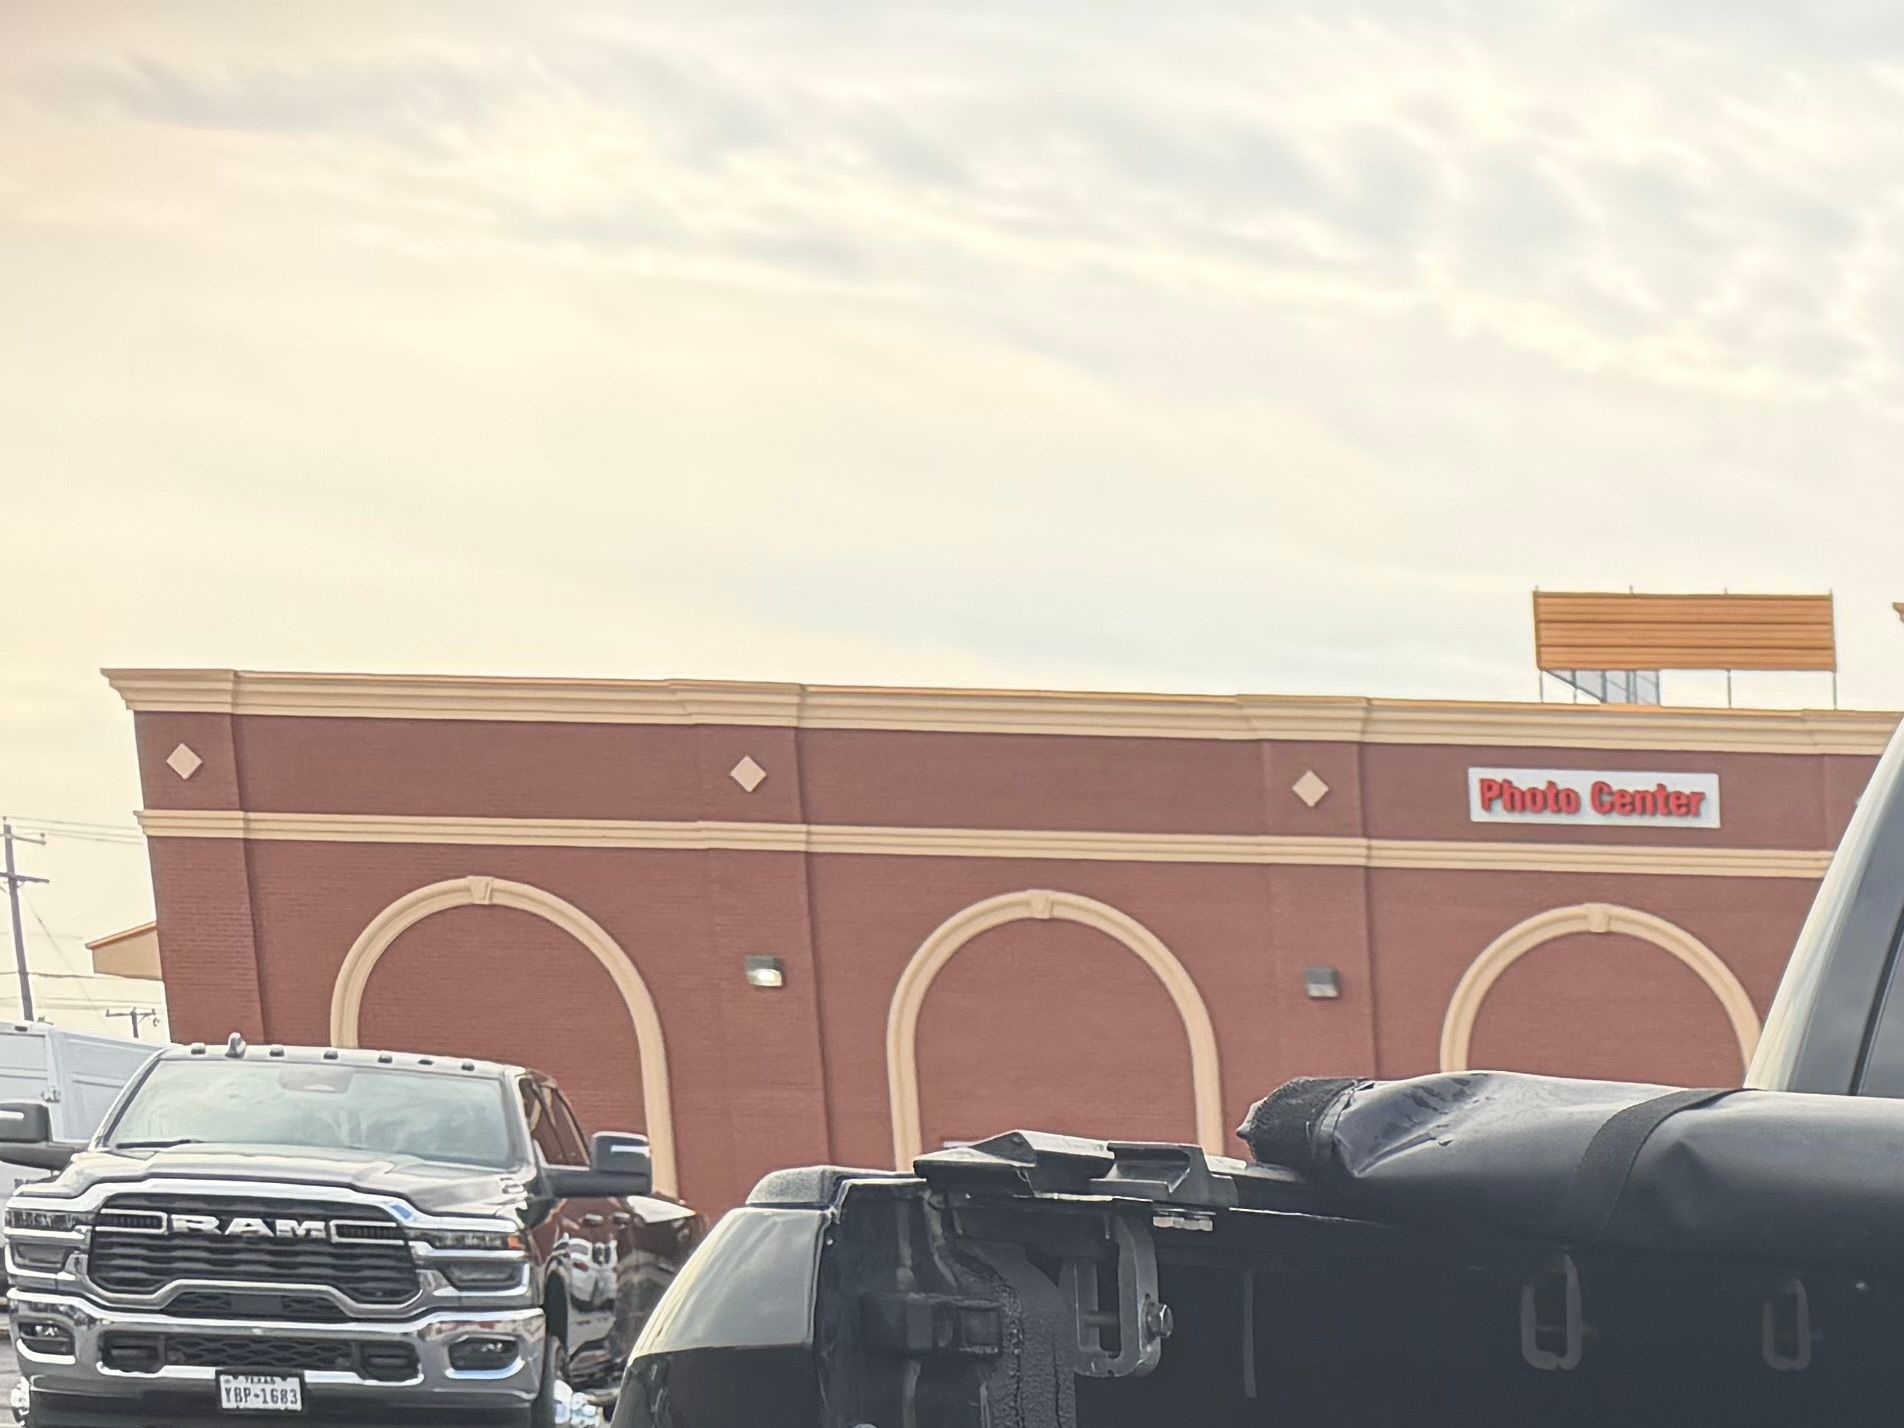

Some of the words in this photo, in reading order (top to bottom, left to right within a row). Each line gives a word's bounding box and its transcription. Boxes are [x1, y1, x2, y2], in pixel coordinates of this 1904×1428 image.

[1479, 778, 1581, 815] Photo
[1590, 780, 1706, 817] Center
[170, 1214, 327, 1238] RAM
